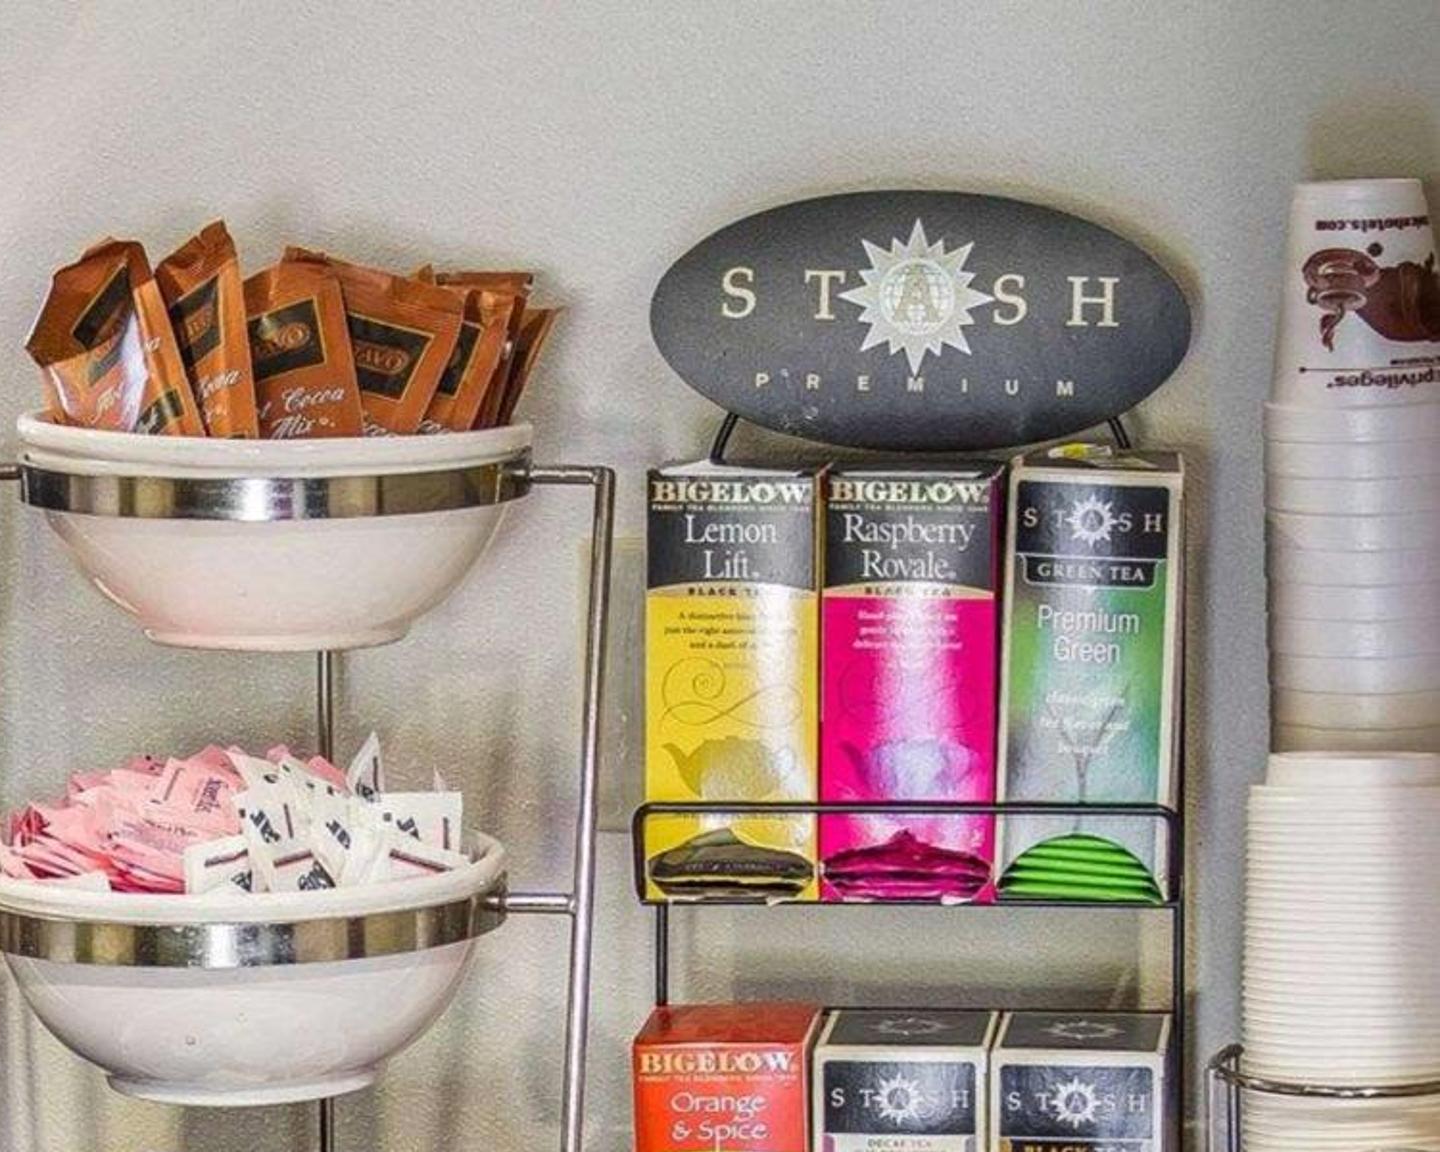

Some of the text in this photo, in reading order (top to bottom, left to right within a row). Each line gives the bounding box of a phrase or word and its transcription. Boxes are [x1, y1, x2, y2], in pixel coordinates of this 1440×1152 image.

[720, 266, 1120, 326] STASH
[755, 372, 1074, 397] PREMIUM
[651, 481, 812, 504] BIGELOW
[829, 481, 990, 504] BIGELOW
[685, 514, 777, 543] Lemon
[843, 513, 975, 551] Raspberry
[1023, 507, 1163, 534] STASH
[1037, 563, 1145, 582] GREEN TEA
[1037, 604, 1140, 634] Premium
[1053, 635, 1120, 664] Green
[639, 1052, 796, 1073] BIGELOW
[671, 1091, 767, 1122] Orange
[830, 1086, 969, 1110] STAH
[1007, 1091, 1145, 1113] STASH
[671, 1120, 767, 1152] & Spice
